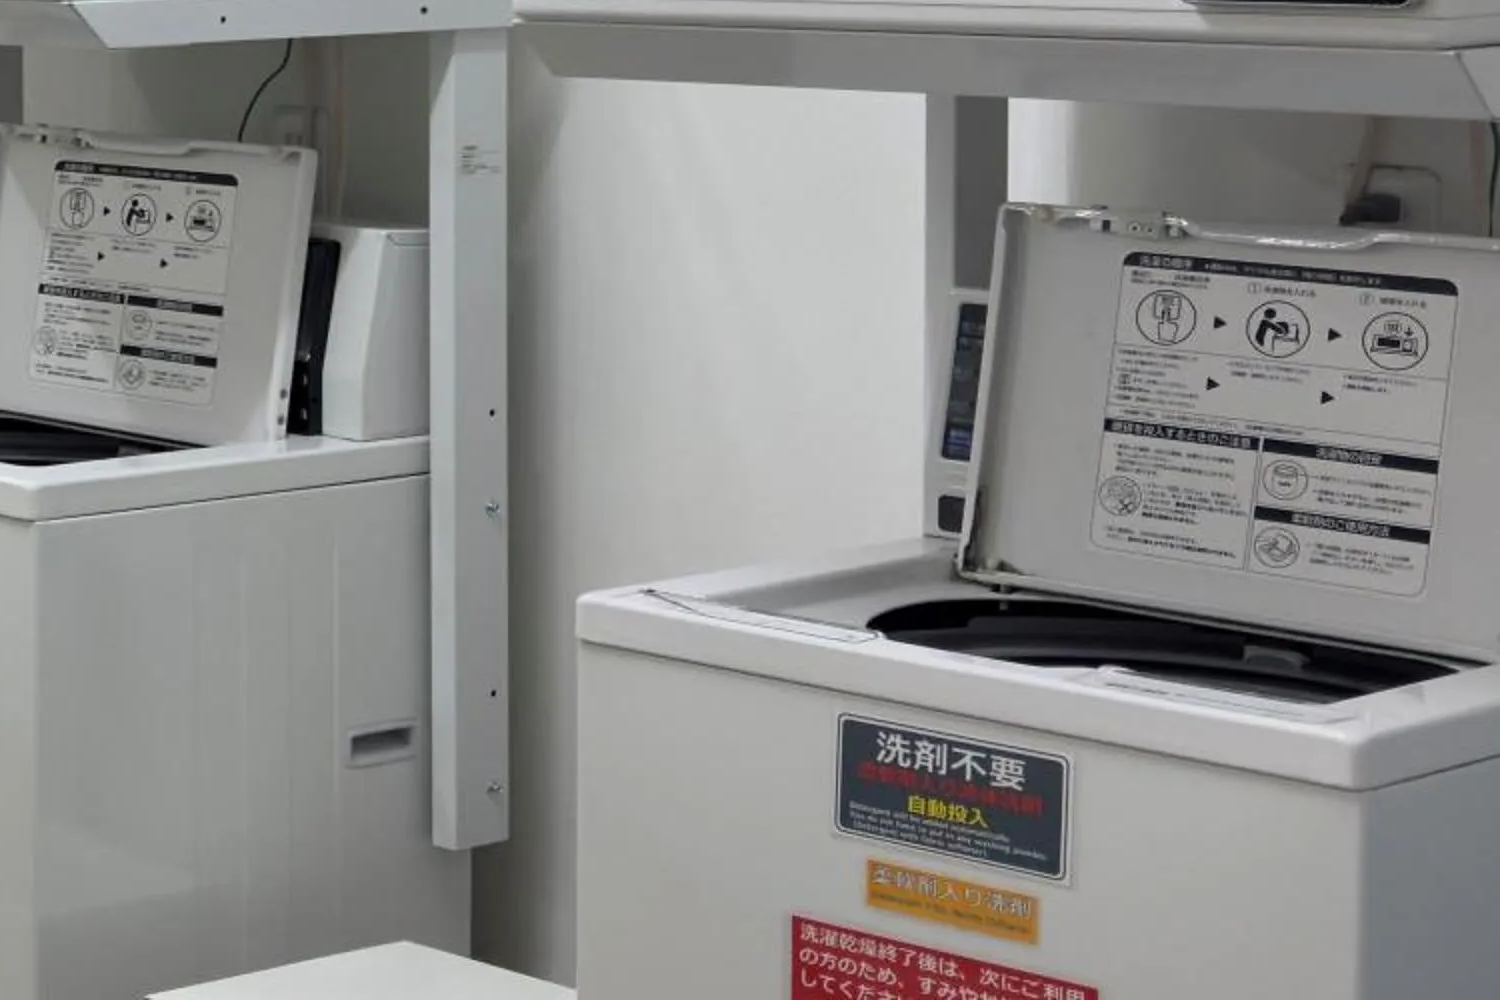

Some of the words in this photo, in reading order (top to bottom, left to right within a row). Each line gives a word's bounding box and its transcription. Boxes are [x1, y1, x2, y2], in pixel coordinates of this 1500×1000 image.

[876, 731, 1027, 792] 洗剤不要
[908, 795, 989, 829] 自動投入
